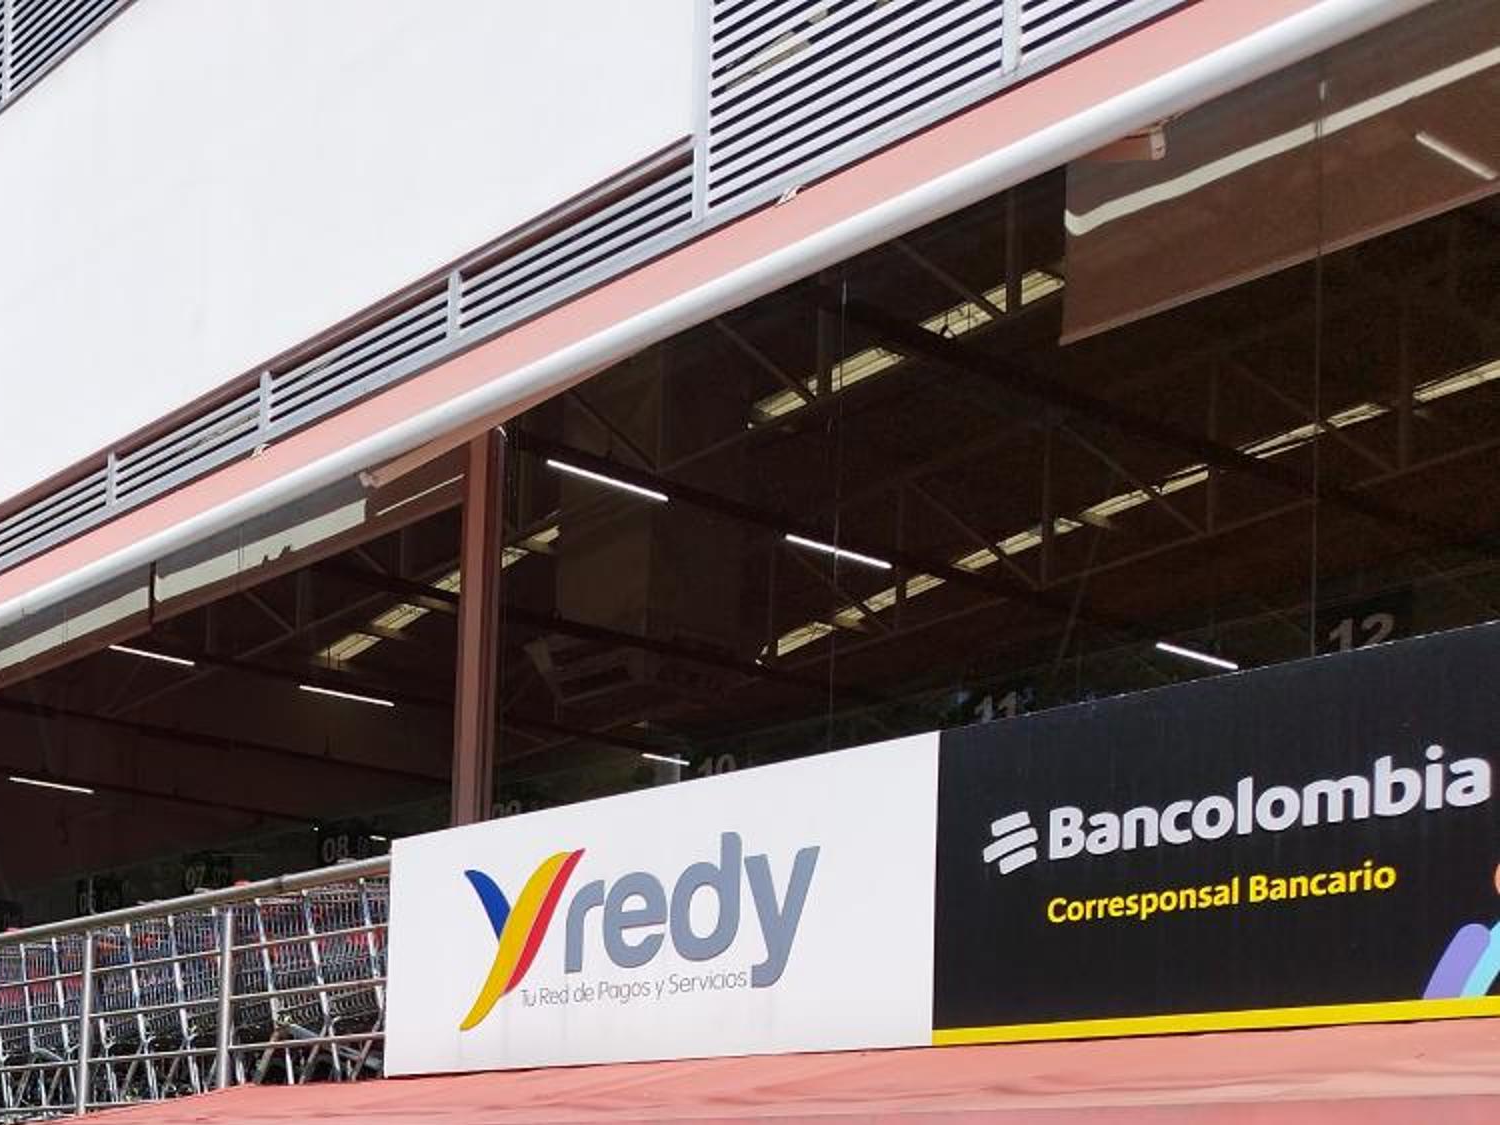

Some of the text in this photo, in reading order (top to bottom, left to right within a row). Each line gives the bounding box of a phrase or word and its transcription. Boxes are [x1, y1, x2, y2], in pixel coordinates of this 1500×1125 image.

[1329, 613, 1395, 649] 12
[1048, 745, 1492, 860] Bancolombia
[1047, 861, 1397, 923] Corresponsal Bancario
[520, 970, 748, 1007] Tu Red de Pagos y Servicios
